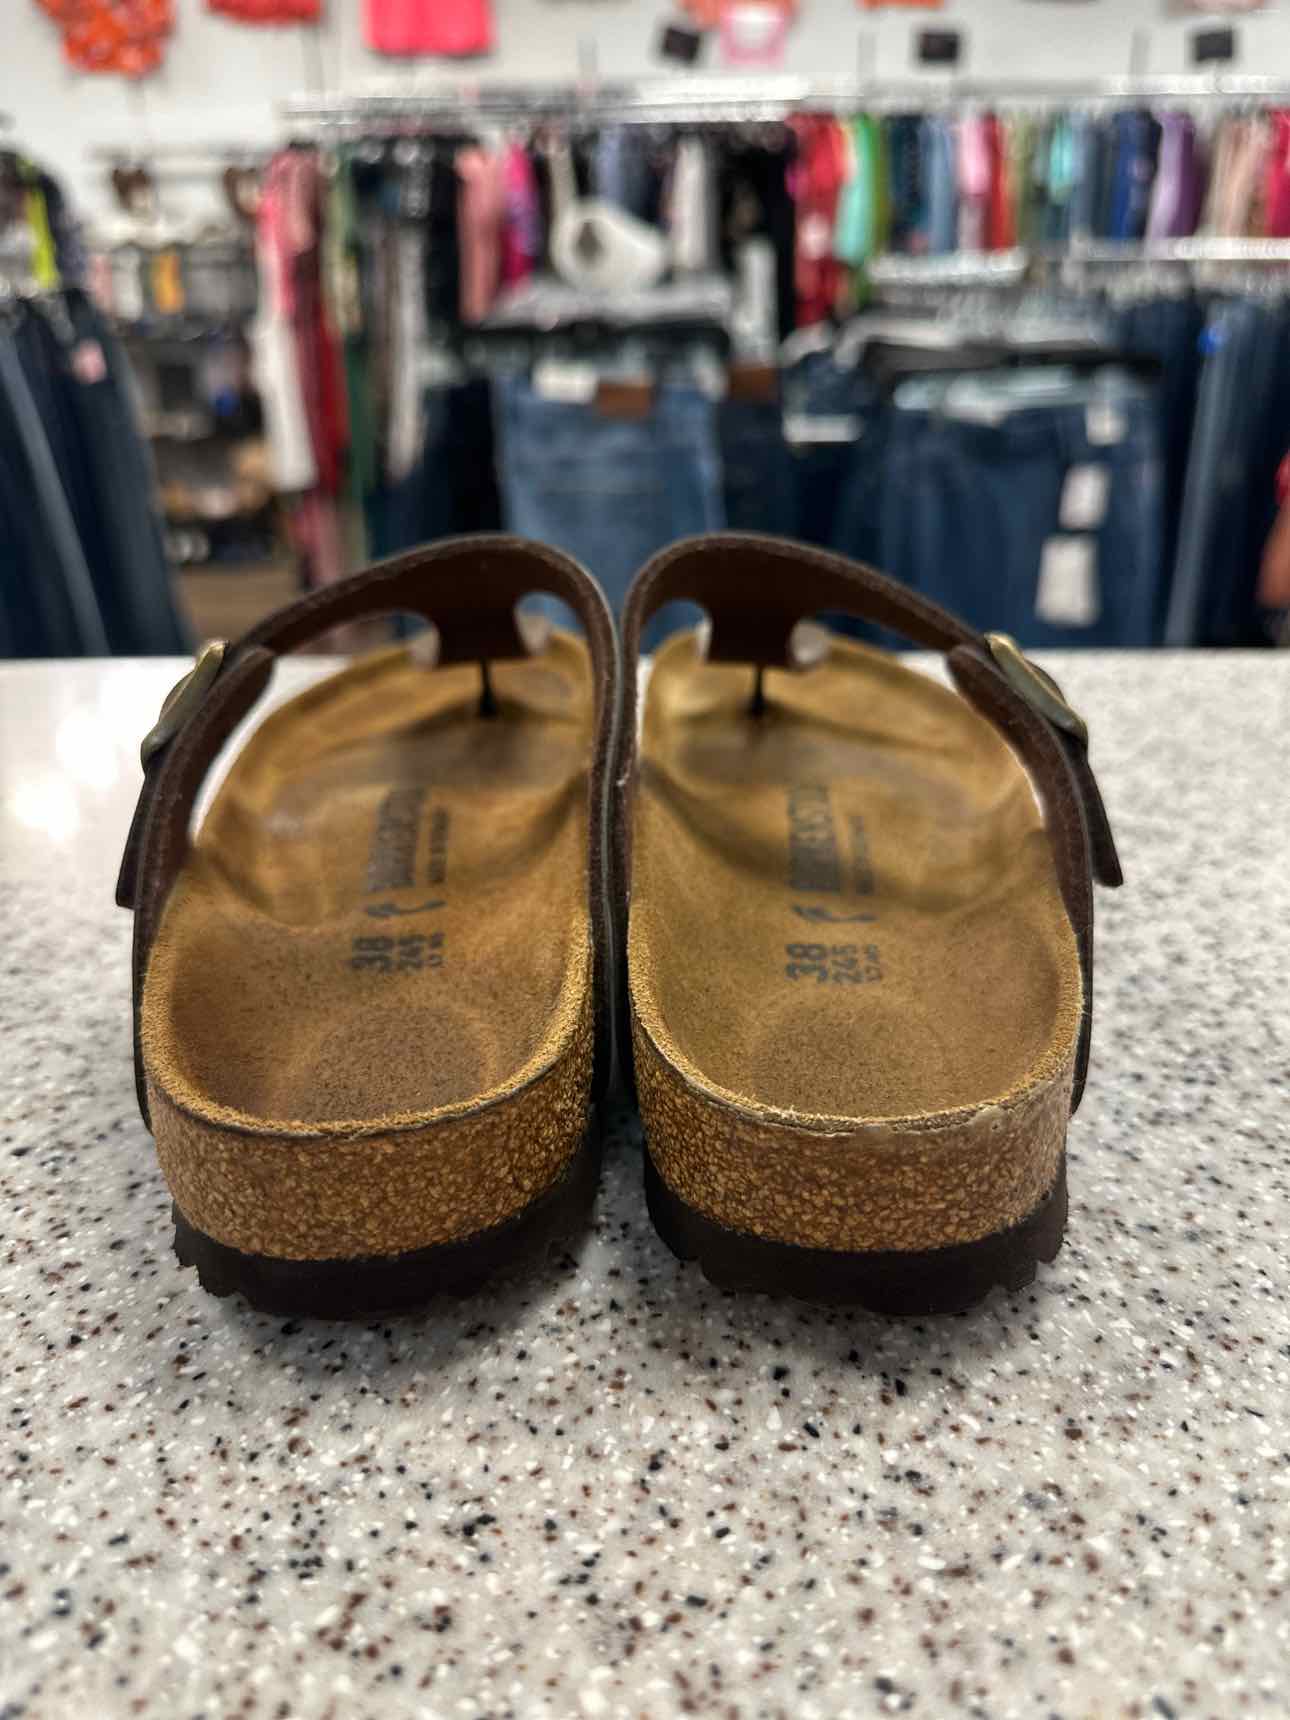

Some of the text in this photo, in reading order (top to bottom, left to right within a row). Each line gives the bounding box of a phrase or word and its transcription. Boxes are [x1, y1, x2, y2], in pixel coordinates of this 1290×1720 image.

[350, 936, 394, 972] 38
[785, 943, 828, 983] 38
[831, 944, 863, 984] 245
